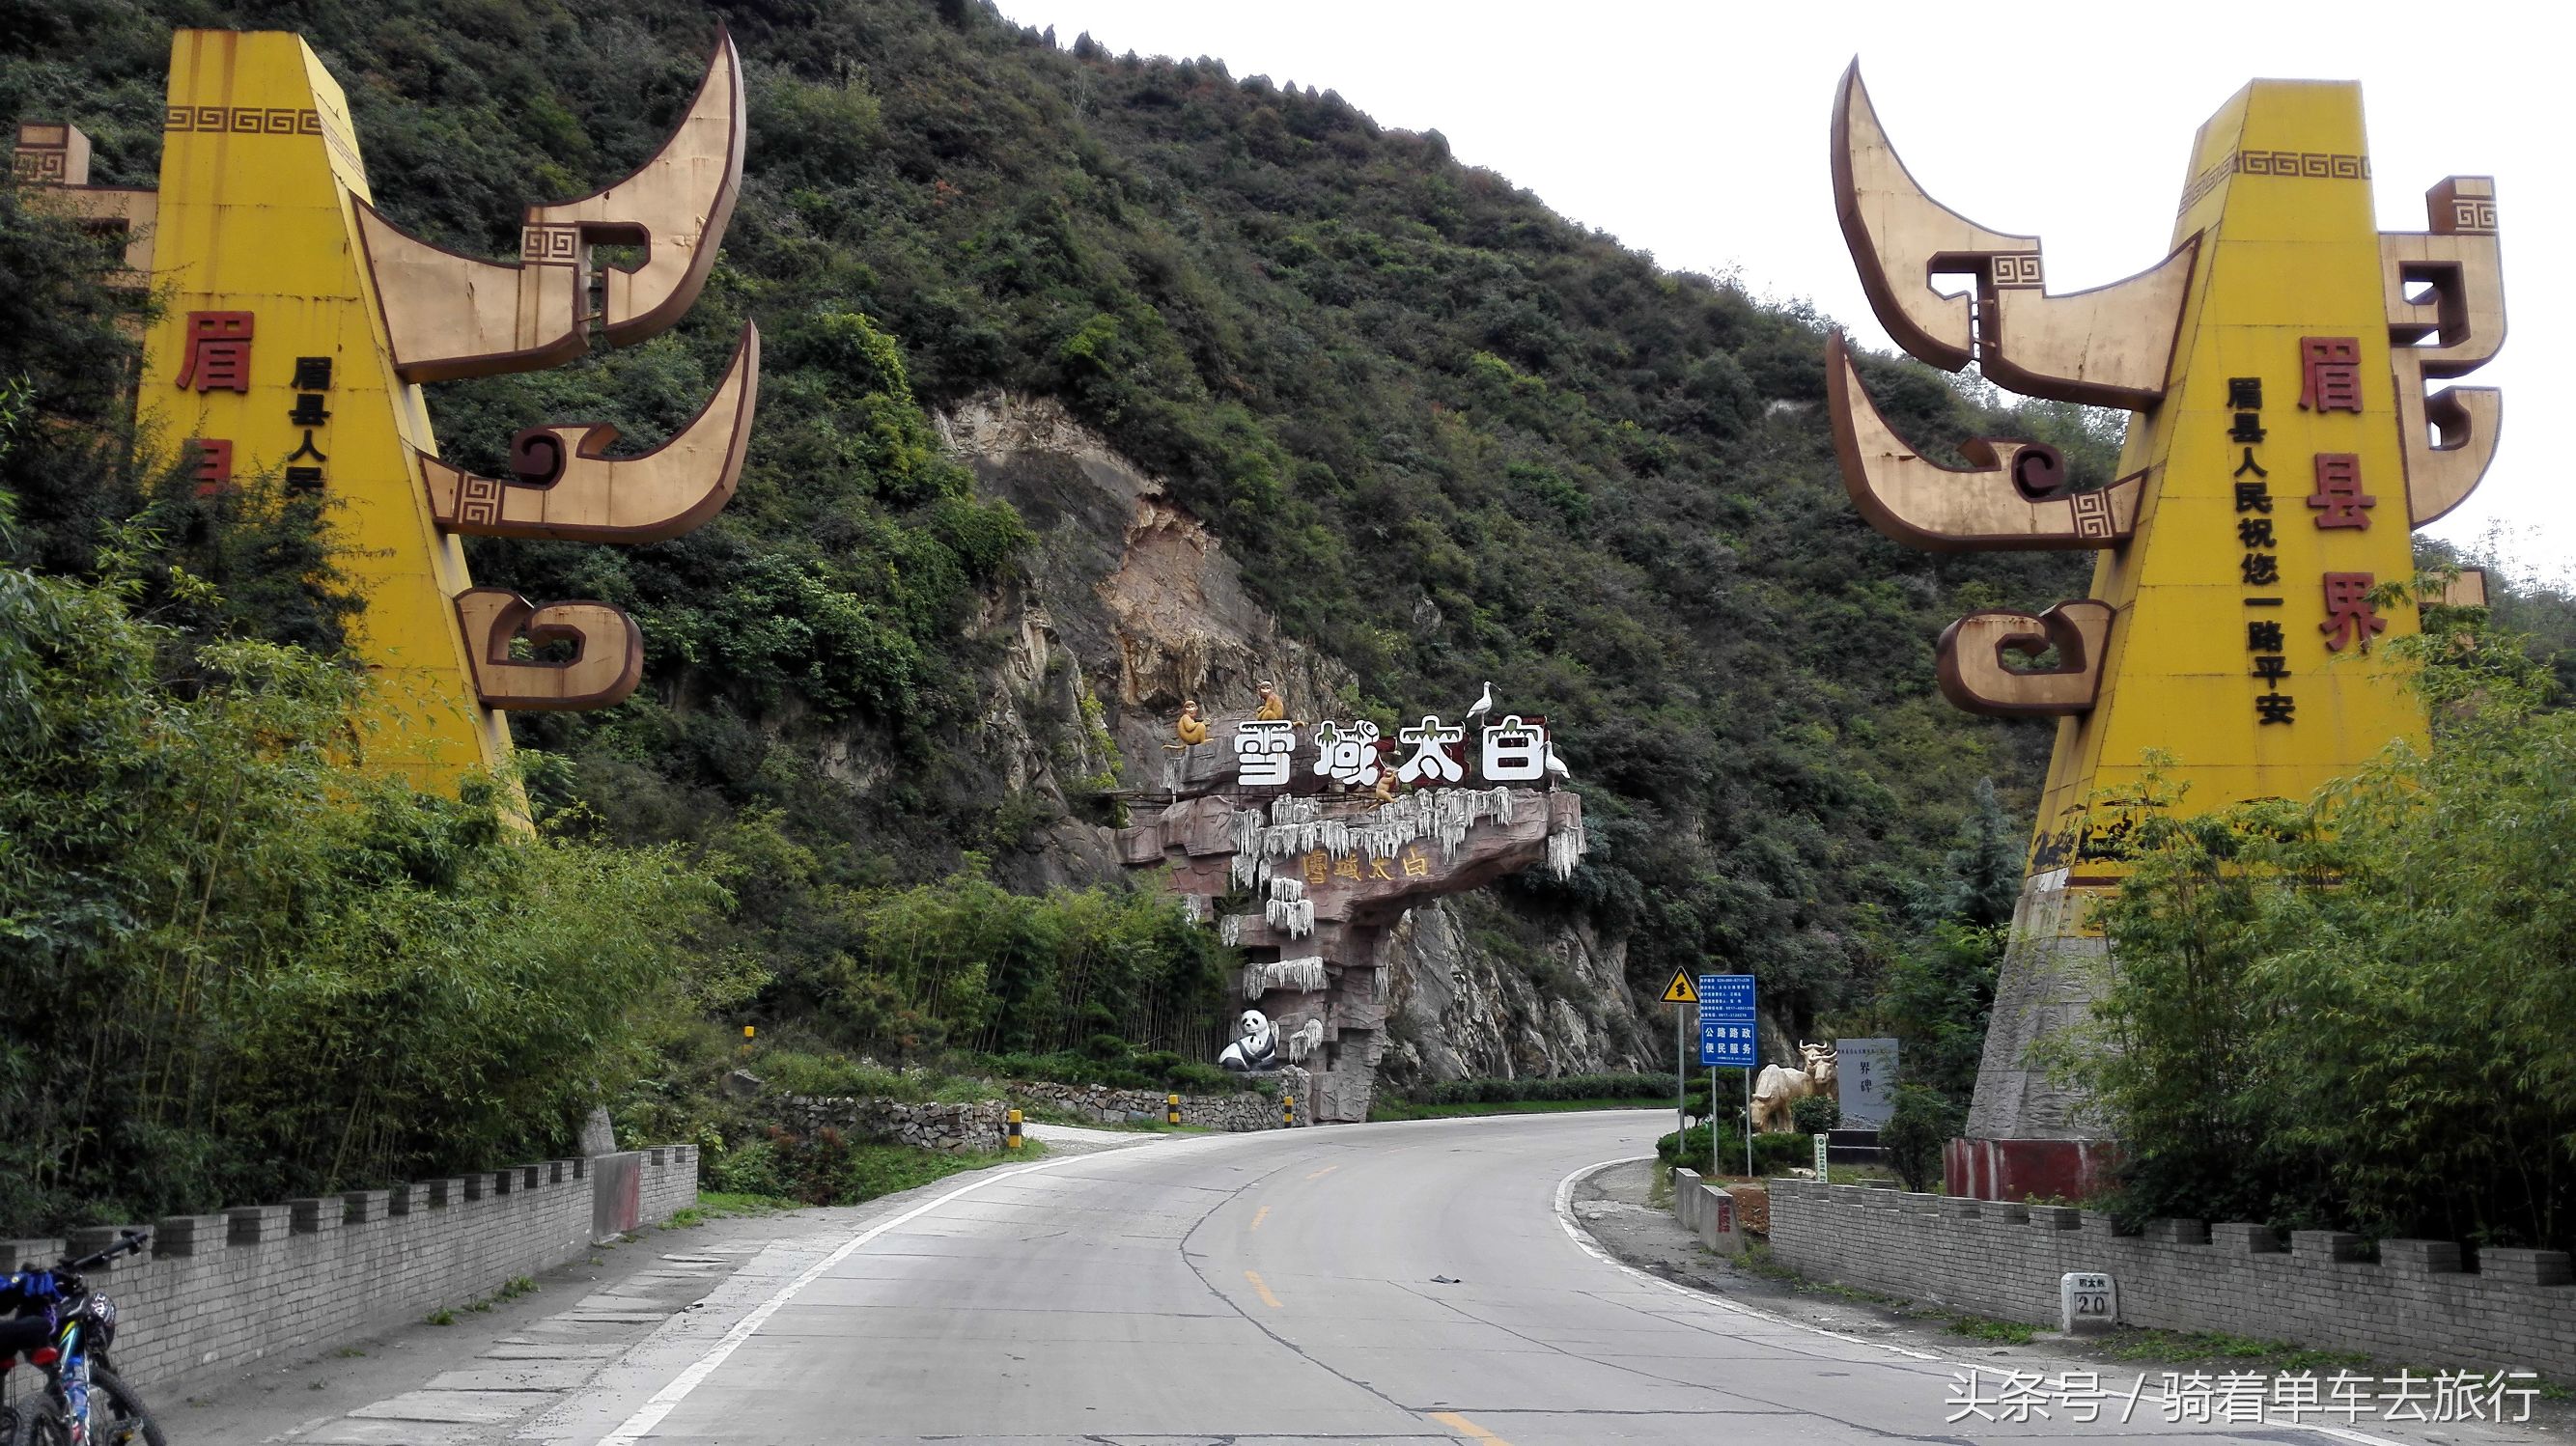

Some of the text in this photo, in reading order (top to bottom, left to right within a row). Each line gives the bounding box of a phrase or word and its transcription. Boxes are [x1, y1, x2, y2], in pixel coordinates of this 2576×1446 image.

[2298, 336, 2388, 654] 眉县界
[2226, 377, 2296, 725] 眉县人民祝您一路平安
[1234, 715, 1545, 786] 雪域太白
[1302, 846, 1428, 884] 雪域太白
[1705, 1027, 1751, 1039] 公路路政
[1705, 1043, 1751, 1055] 便民服务
[2078, 1295, 2106, 1314] 20
